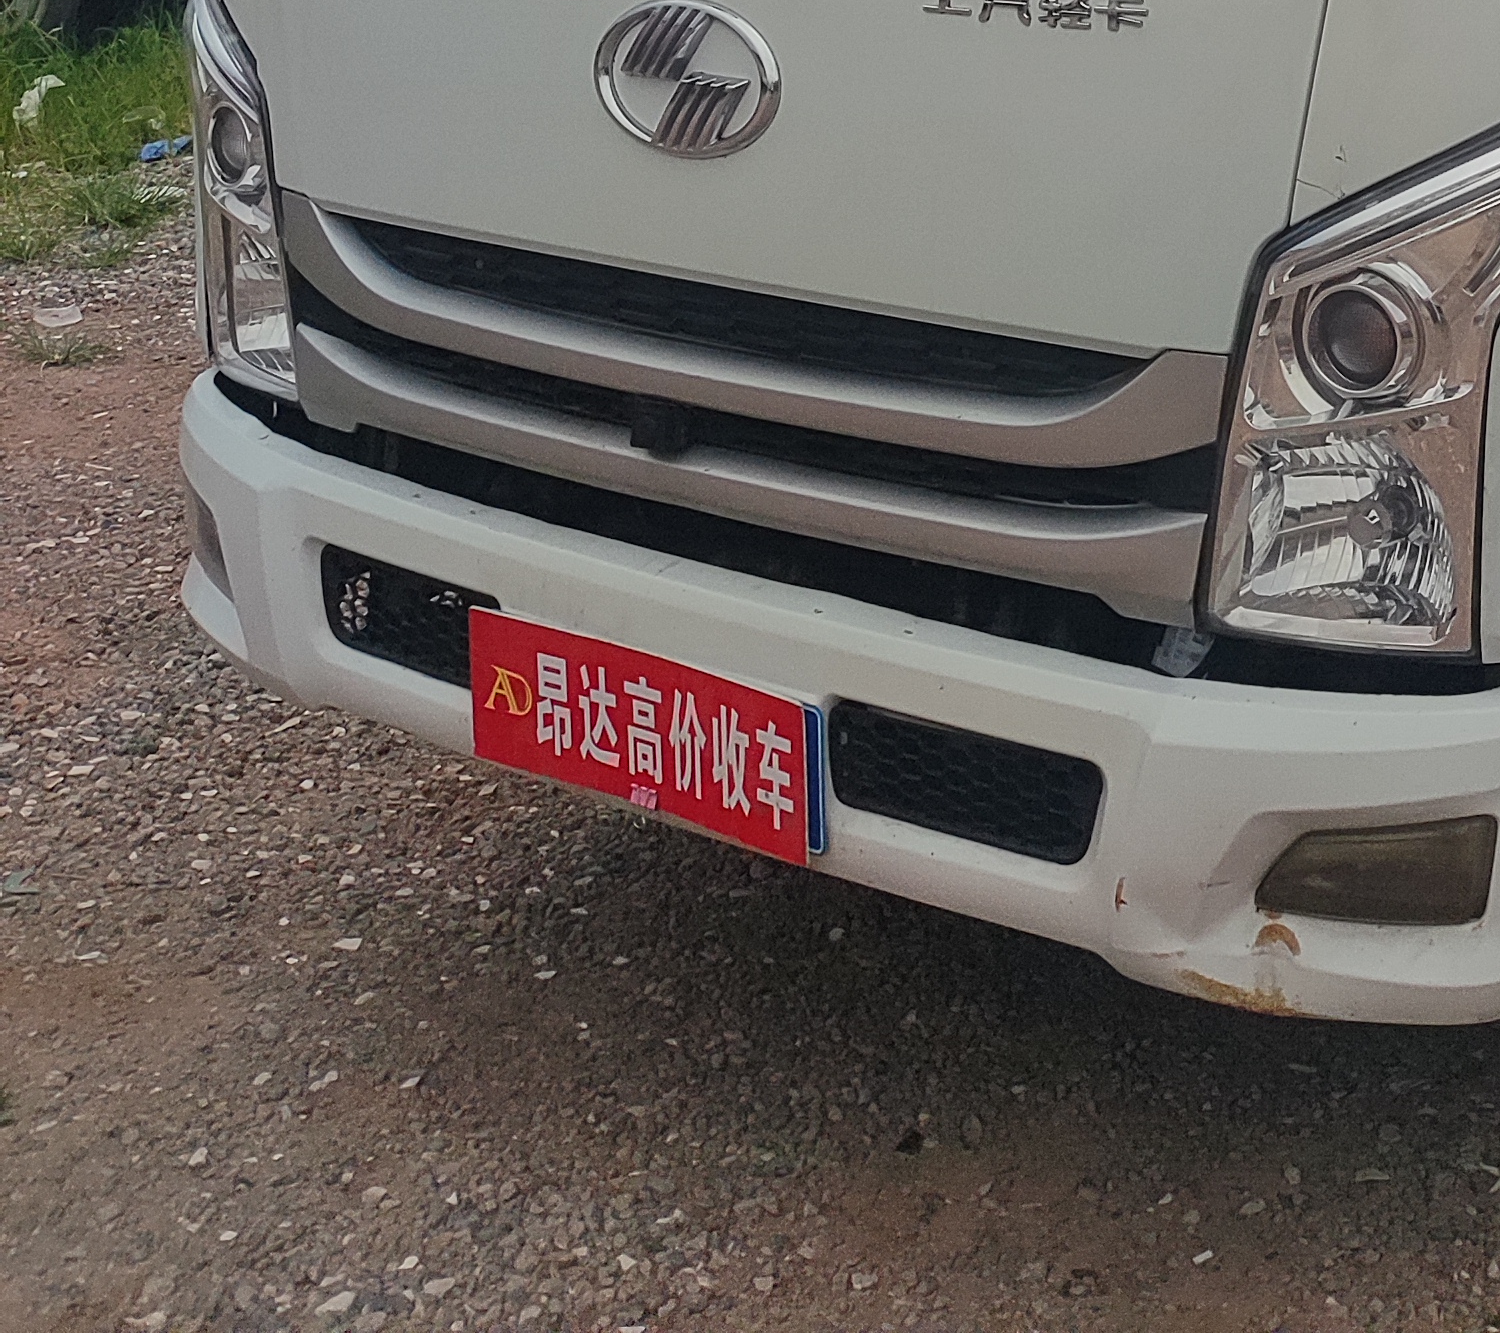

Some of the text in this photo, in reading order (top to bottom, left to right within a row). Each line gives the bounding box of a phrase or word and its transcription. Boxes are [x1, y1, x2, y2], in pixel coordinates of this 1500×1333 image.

[536, 652, 795, 831] 昂达高价收车
